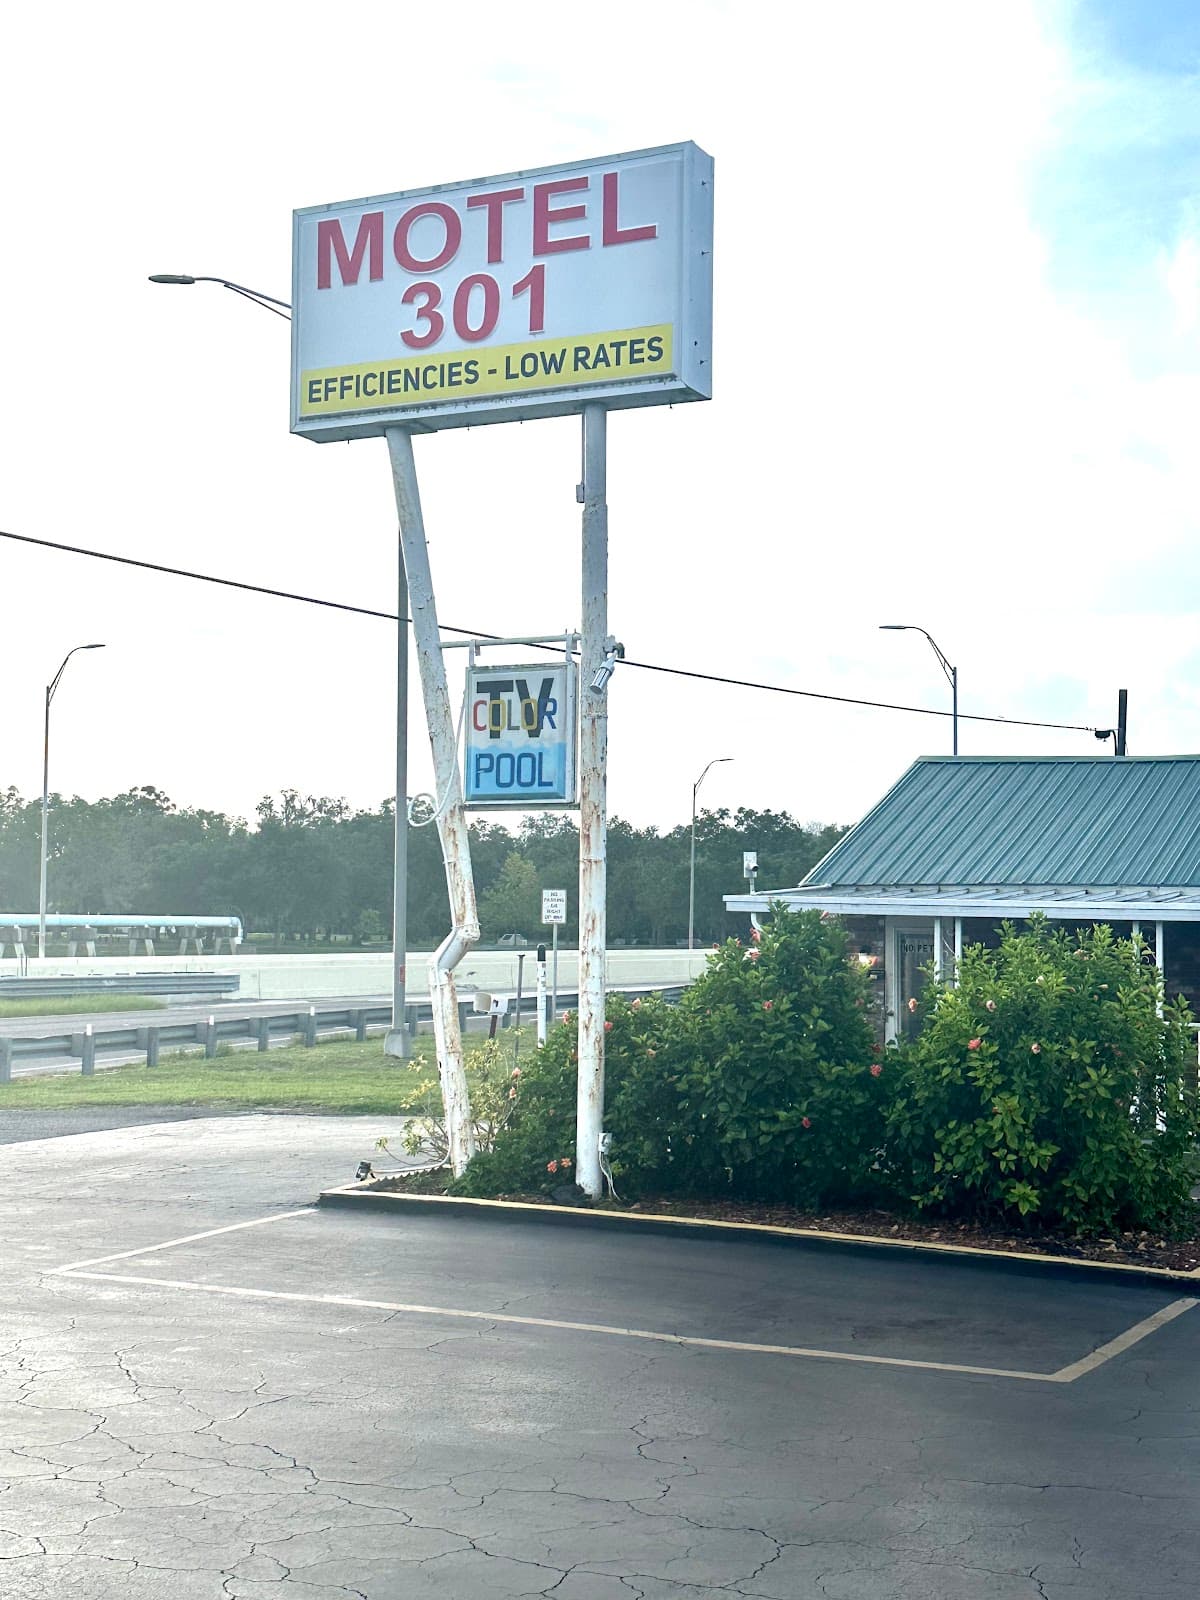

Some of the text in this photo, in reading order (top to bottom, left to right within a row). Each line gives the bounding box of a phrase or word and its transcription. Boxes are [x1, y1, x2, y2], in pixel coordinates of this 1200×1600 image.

[317, 171, 657, 290] MOTEL
[400, 264, 546, 349] 301
[308, 360, 479, 402] EFFICIENCIES
[504, 348, 566, 380] LOW
[573, 336, 664, 371] RATES
[473, 699, 557, 731] COLOR
[477, 678, 554, 739] TV
[475, 752, 553, 788] POOL
